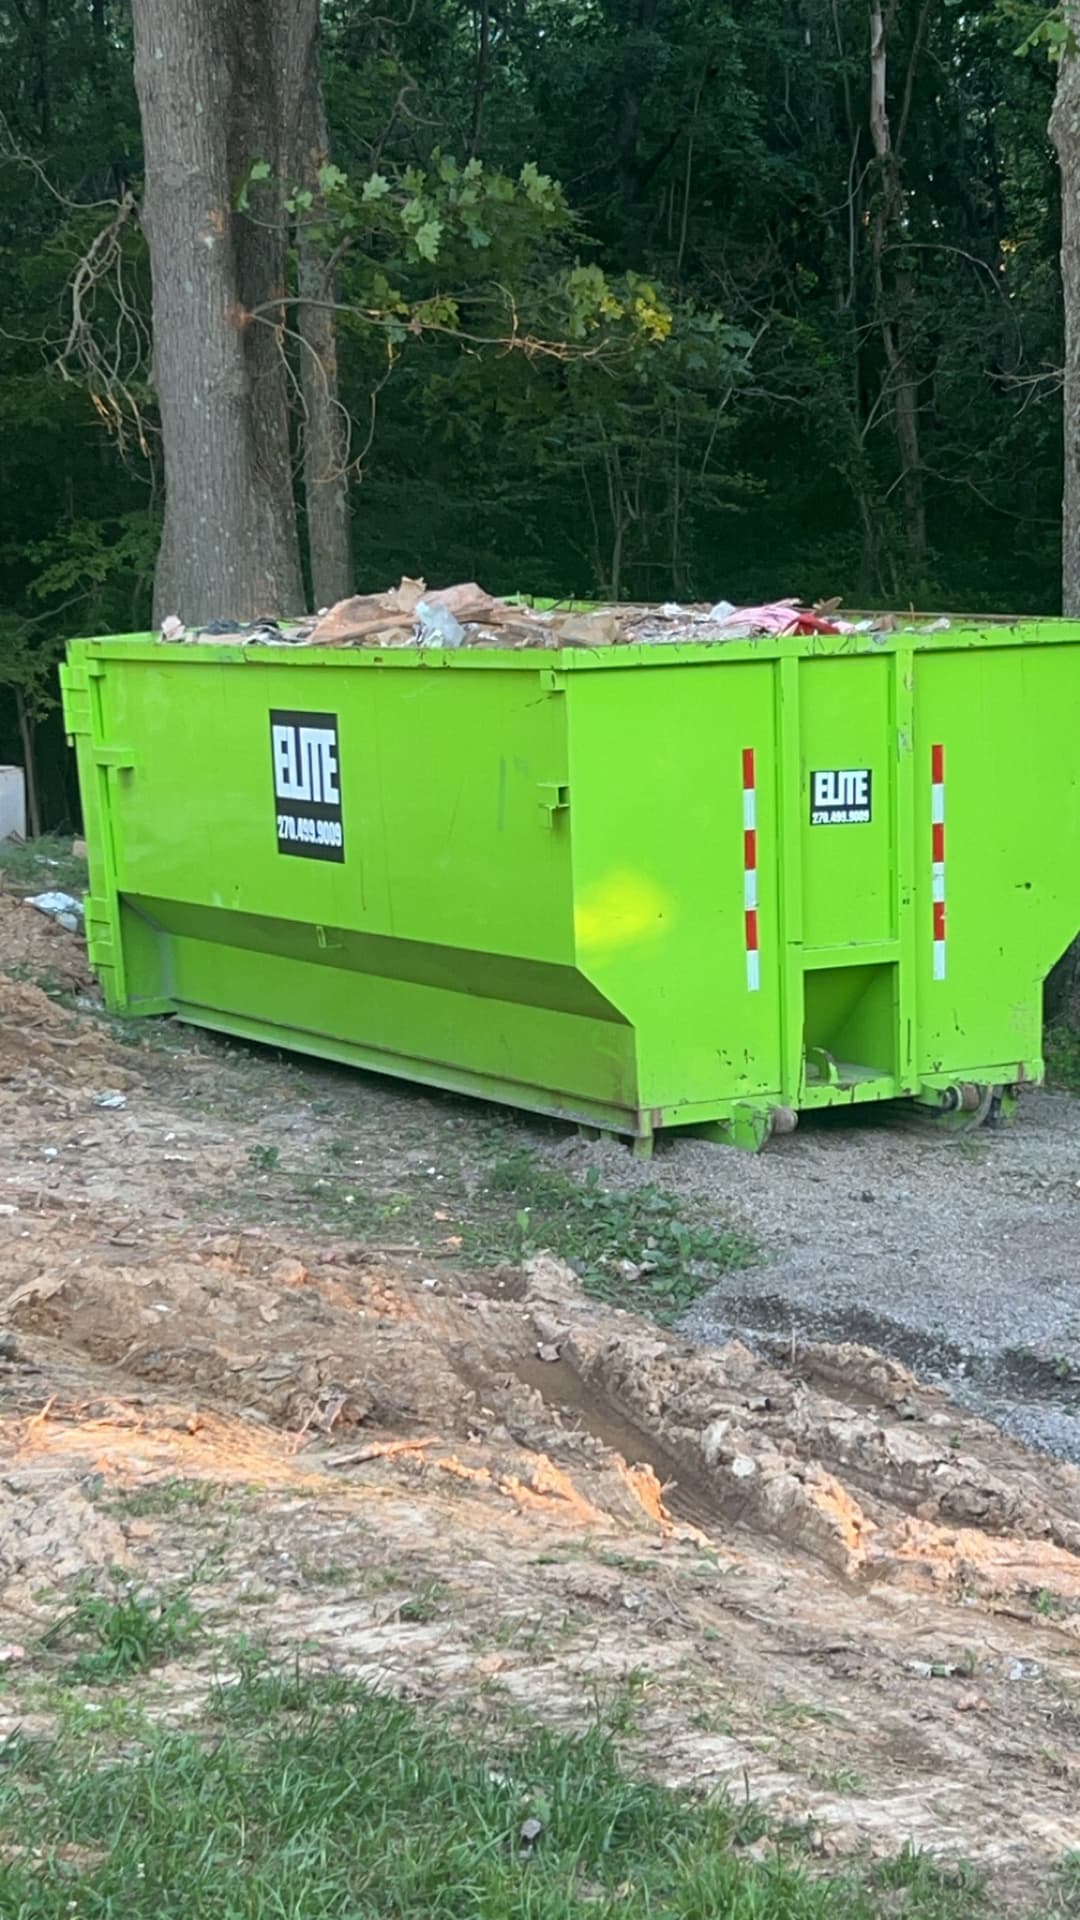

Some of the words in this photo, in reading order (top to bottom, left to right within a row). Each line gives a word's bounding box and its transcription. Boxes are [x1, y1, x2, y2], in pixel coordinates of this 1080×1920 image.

[272, 725, 339, 803] ELITE
[815, 771, 868, 806] ELITE
[277, 815, 343, 847] 270.499.9009
[812, 810, 869, 824] 270.499.9009
